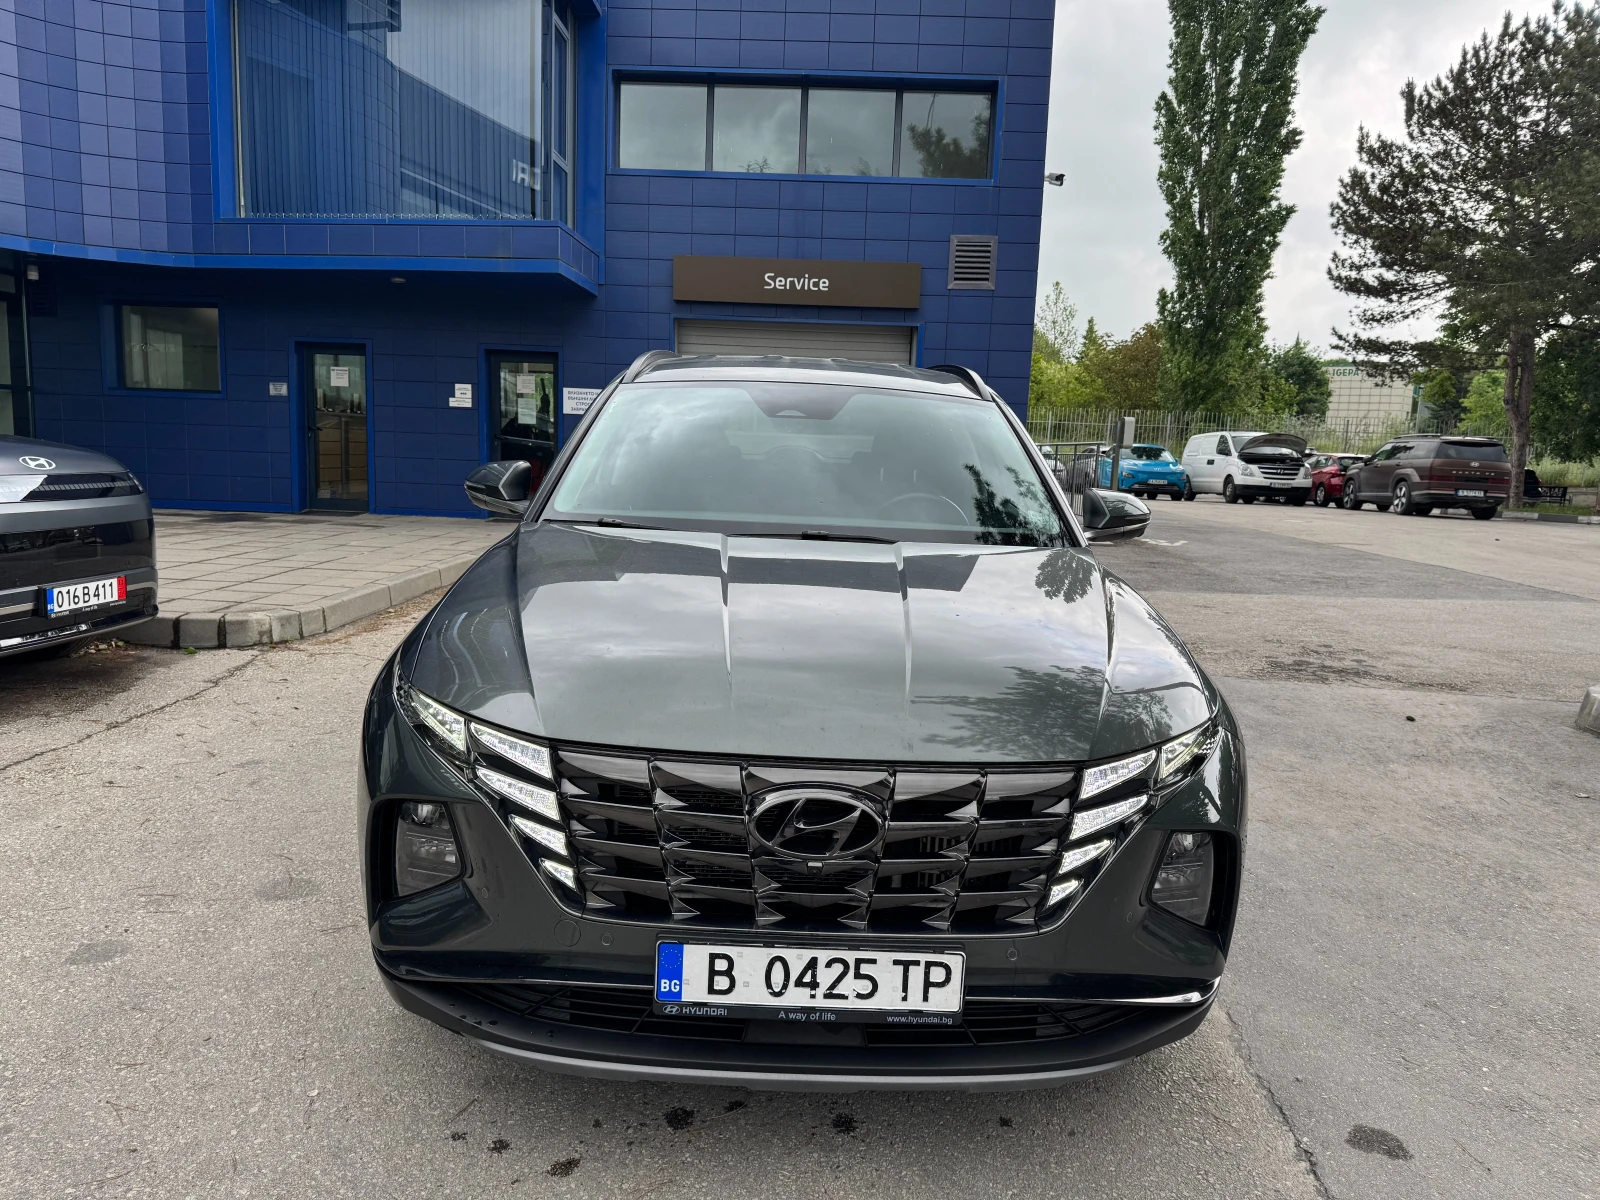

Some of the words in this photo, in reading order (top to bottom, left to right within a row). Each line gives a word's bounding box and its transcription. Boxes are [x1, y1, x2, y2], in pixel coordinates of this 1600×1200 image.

[764, 272, 829, 291] Service
[1332, 368, 1359, 377] IGEPA
[707, 952, 736, 996] B
[764, 955, 879, 1001] 0425
[892, 958, 952, 1003] TP
[660, 979, 680, 992] BG
[682, 1007, 728, 1016] HYUNDAI
[778, 1011, 786, 1019] A
[788, 1012, 807, 1021] way
[810, 1012, 820, 1020] of
[822, 1012, 837, 1021] life
[886, 1015, 953, 1025] www.hyundai.bg
